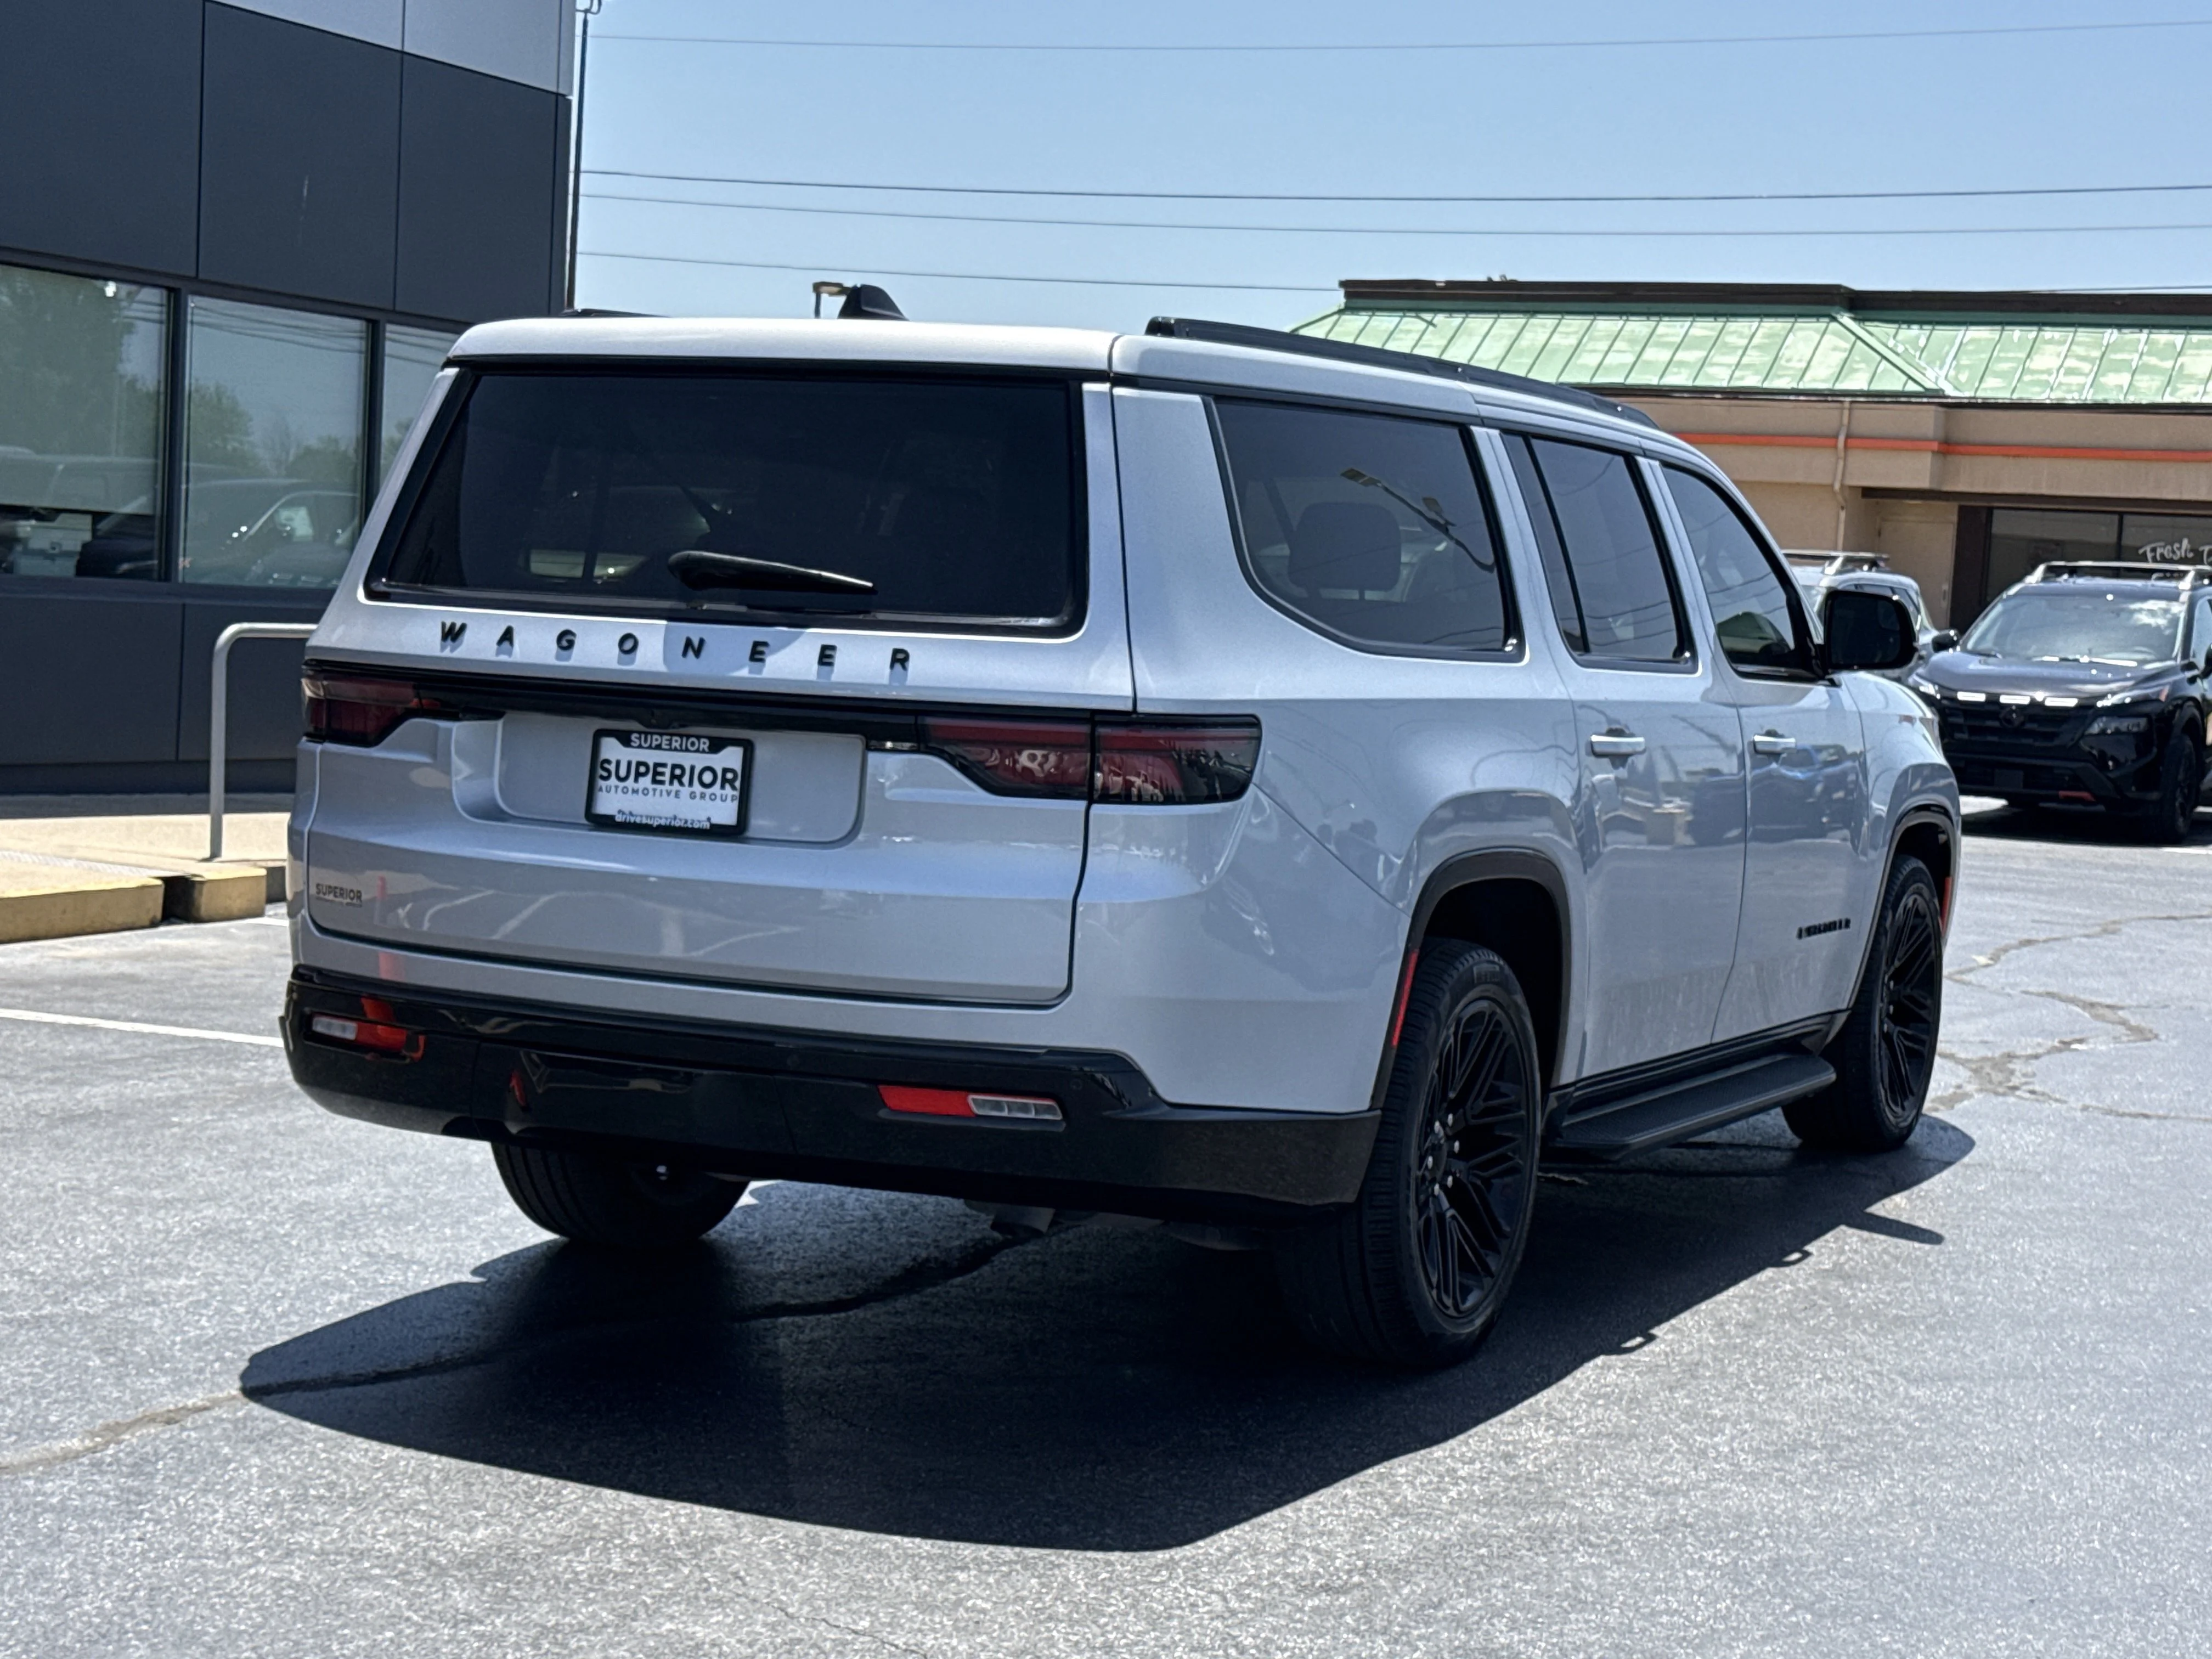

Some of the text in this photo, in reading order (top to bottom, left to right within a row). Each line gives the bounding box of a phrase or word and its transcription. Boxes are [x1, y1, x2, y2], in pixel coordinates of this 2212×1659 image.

[2138, 537, 2194, 563] Fresh
[440, 620, 910, 670] WAGONEER
[630, 732, 709, 752] SUPERIOR
[599, 758, 739, 791] SUPERIOR
[598, 785, 738, 803] AUTOMOTIVE GROUP
[615, 811, 710, 830] drivesuperior.com
[315, 883, 362, 902] SUPERIOR
